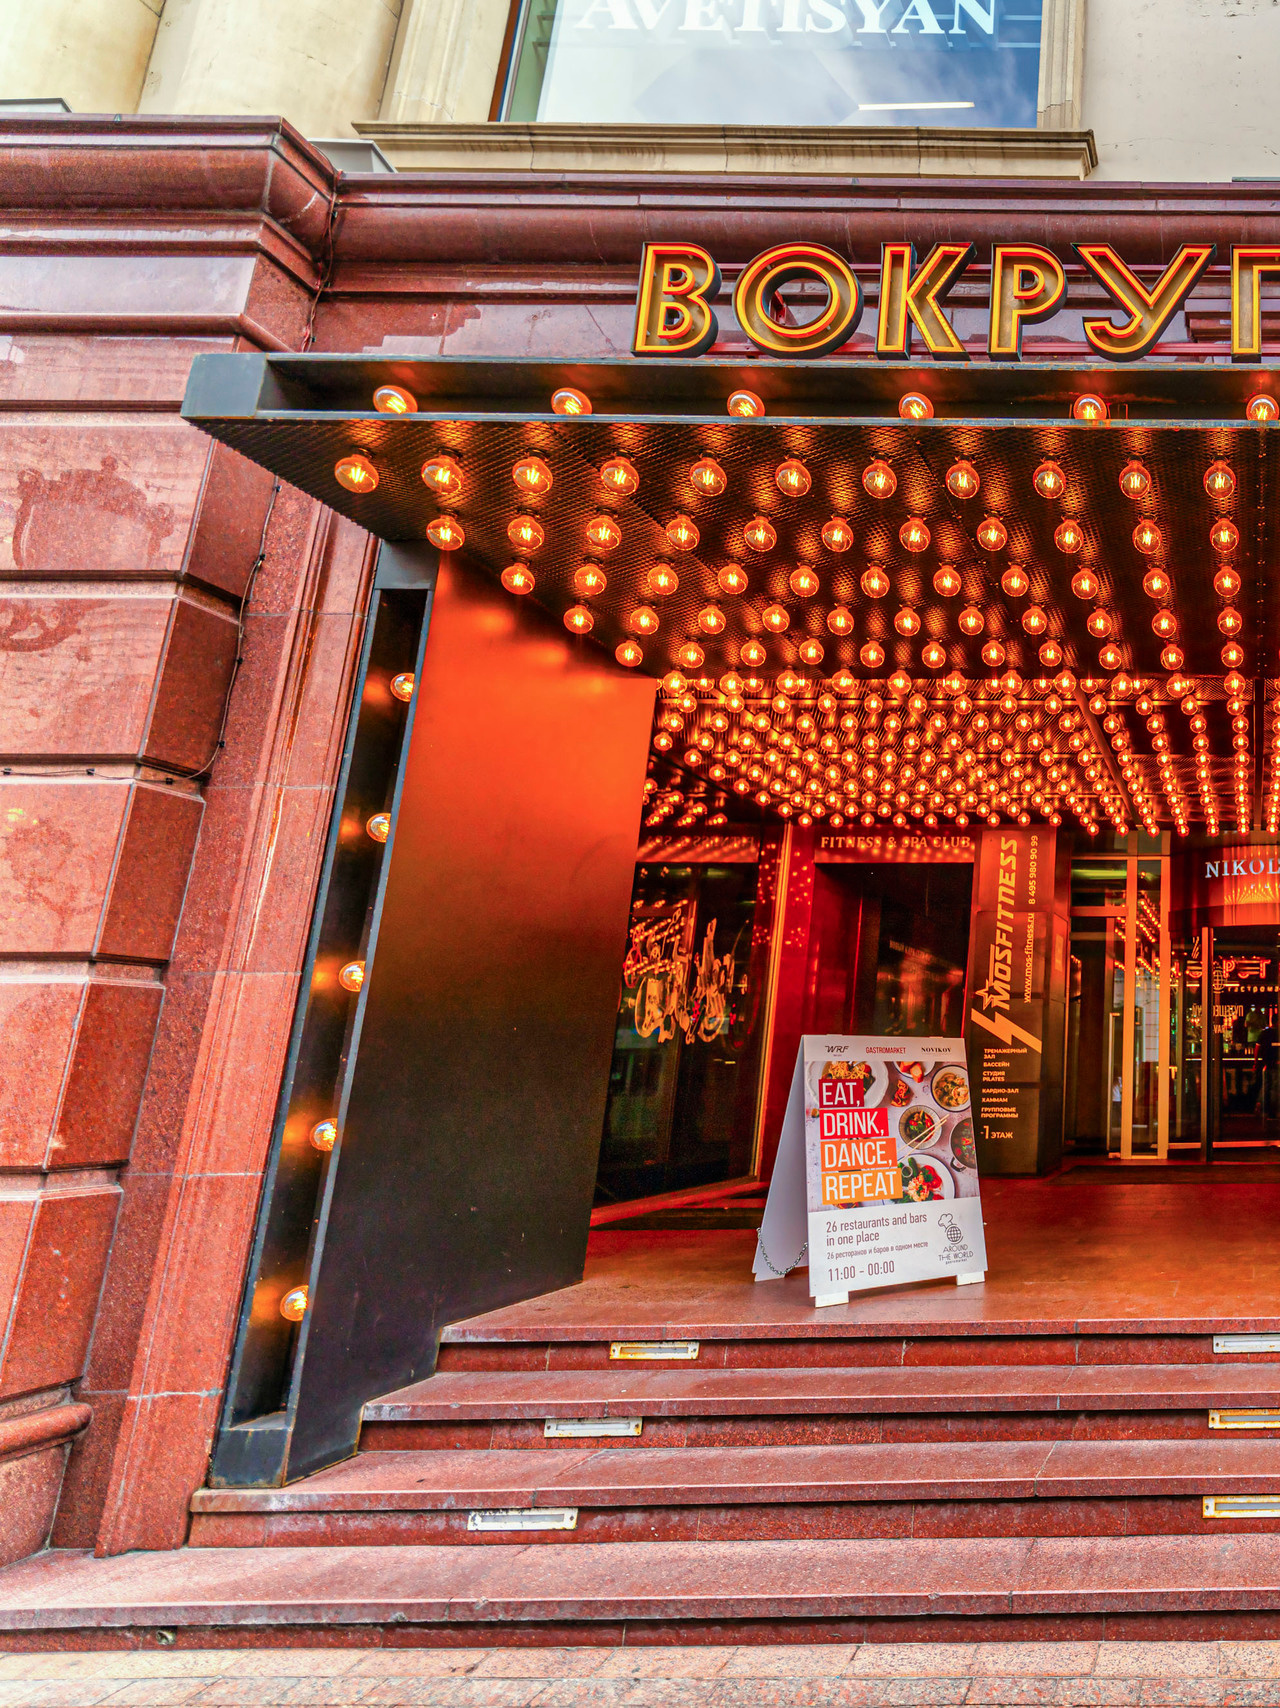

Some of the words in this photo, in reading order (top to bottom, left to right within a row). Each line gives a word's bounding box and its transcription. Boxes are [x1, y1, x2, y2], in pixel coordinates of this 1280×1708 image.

[820, 836, 881, 848] FITNESS
[888, 837, 896, 848] &
[902, 836, 928, 848] SPA
[933, 836, 970, 848] CLUB
[1030, 836, 1038, 846] 99
[1030, 848, 1038, 860] 90
[1029, 862, 1037, 878] 980
[1028, 880, 1036, 897] 495
[1024, 912, 1034, 1004] www.mos-fitness.ru
[822, 1082, 860, 1106] EAT,
[823, 1111, 884, 1136] DRINK,
[824, 1141, 892, 1168] DANCE,
[825, 1171, 897, 1201] REPEAT
[826, 1221, 838, 1233] 26
[840, 1218, 890, 1232] restaurants
[892, 1213, 908, 1226] and
[910, 1212, 928, 1224] bars
[826, 1235, 835, 1246] in
[838, 1234, 854, 1245] one
[856, 1232, 880, 1246] place
[827, 1252, 834, 1260] 26
[836, 1248, 868, 1260] ресторанов
[874, 1246, 890, 1254] баров
[896, 1244, 913, 1252] одном
[914, 1241, 928, 1249] месте
[943, 1244, 968, 1253] AROUND
[954, 1250, 974, 1260] WORLD
[828, 1265, 856, 1282] 11:00
[868, 1260, 895, 1276] 00:00
